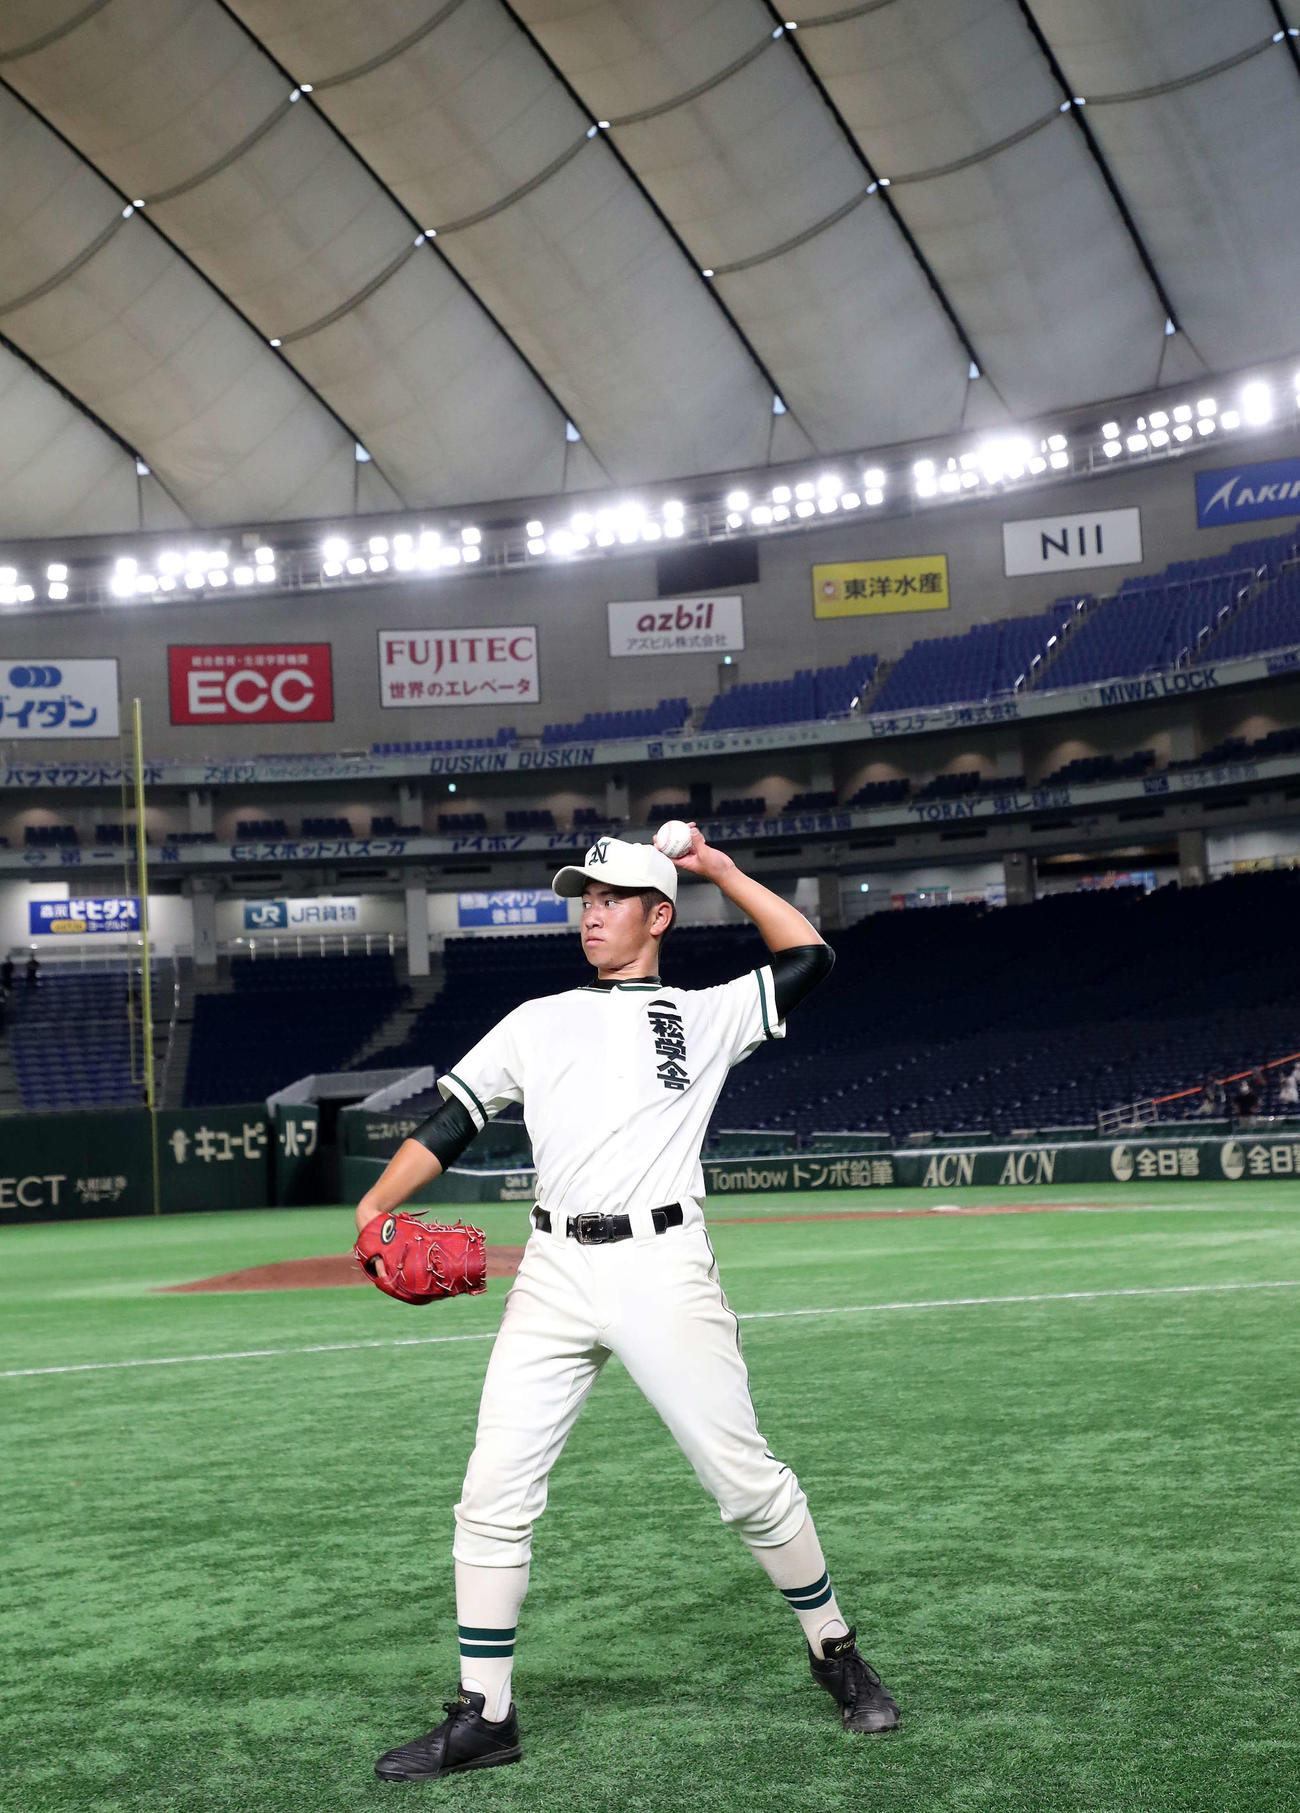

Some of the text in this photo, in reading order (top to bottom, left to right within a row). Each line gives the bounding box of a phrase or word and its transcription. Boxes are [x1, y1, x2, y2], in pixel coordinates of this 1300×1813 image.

[1041, 524, 1103, 560] NII
[843, 572, 943, 600] 東洋水産
[636, 603, 714, 632] azbil
[384, 636, 533, 674] FUJITEC
[626, 634, 728, 650] アズビル株式会社
[187, 669, 315, 715] ECC
[388, 678, 531, 700] 世界のエレベータ
[1100, 668, 1220, 705] MIWA LOCK
[869, 701, 1021, 737] 日本ステージ株式会社
[430, 748, 595, 774] DUSKIN DUSKIN
[5, 767, 164, 786] パラマウントベド
[588, 841, 611, 866] N
[252, 905, 281, 924] JR
[291, 904, 356, 923] JR貨物
[708, 1159, 894, 1191] Tombow トンボ鉛筆
[922, 1149, 1057, 1188] ACN ACN
[1136, 1148, 1200, 1177] 全日警
